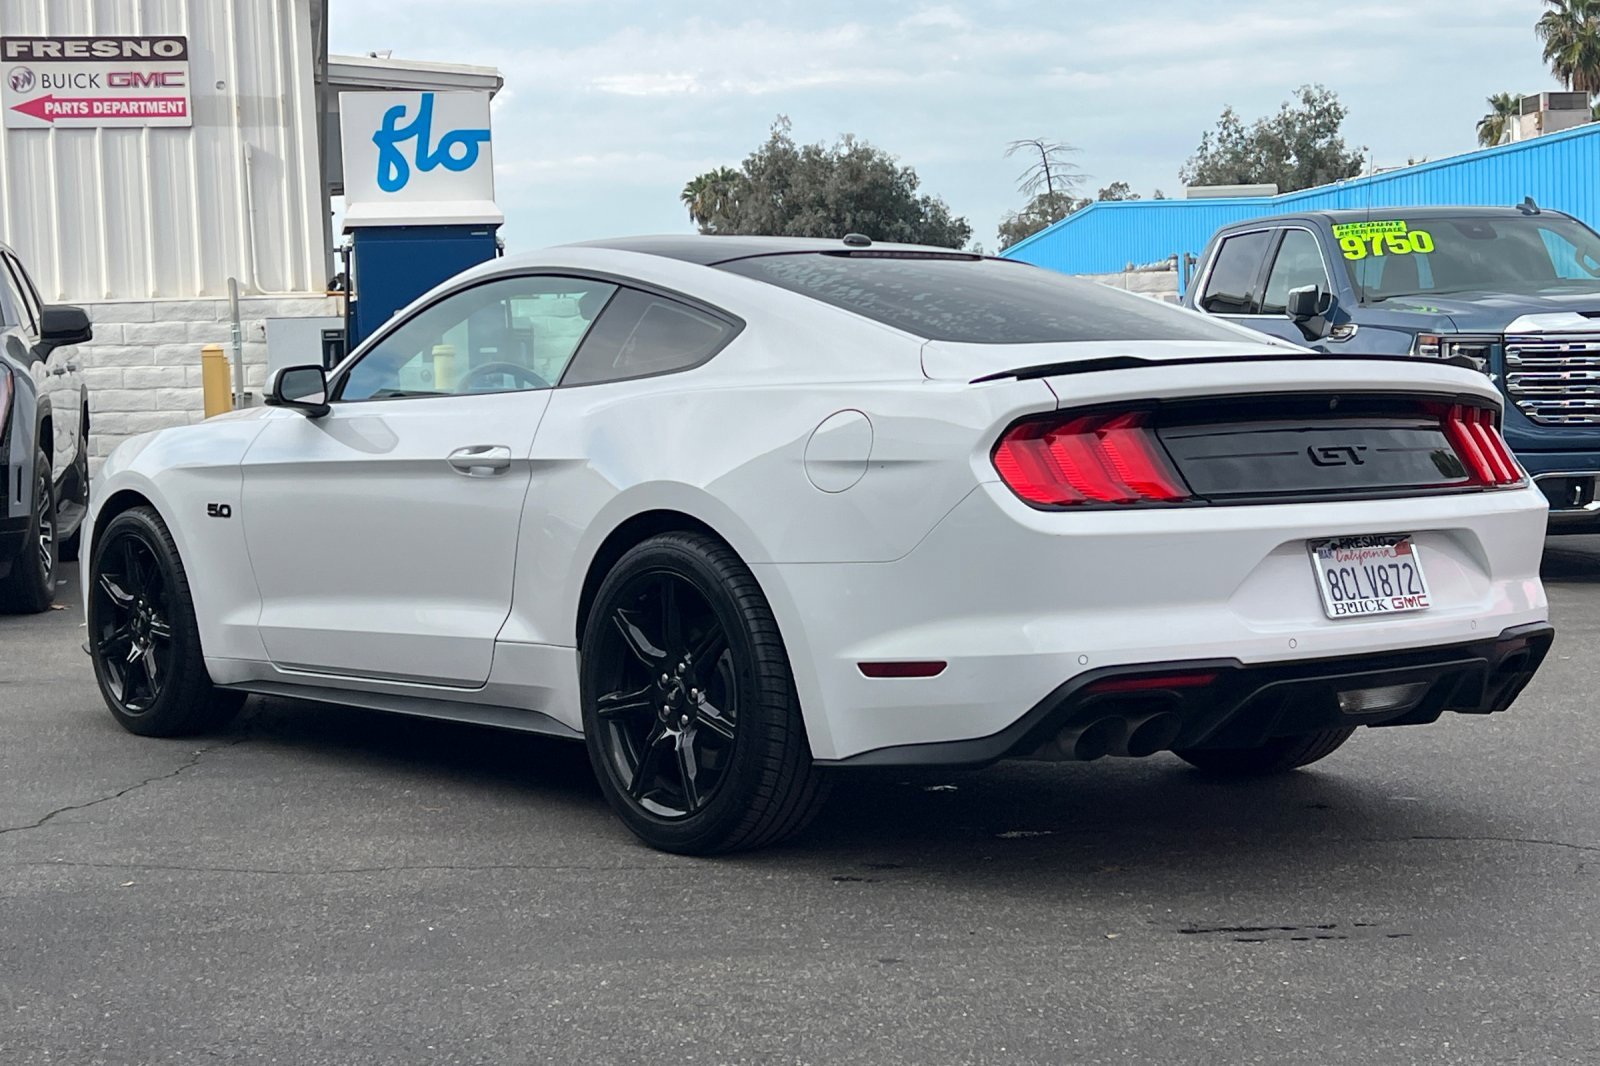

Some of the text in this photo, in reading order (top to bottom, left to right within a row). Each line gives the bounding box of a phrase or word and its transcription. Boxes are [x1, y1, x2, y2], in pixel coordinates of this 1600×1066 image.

[6, 40, 183, 58] FRESNO
[42, 71, 185, 89] BUICK GMC
[44, 101, 184, 115] PARTS DEPARTMENT
[372, 92, 491, 193] flo
[1340, 230, 1435, 260] 9750
[1307, 446, 1367, 467] GT
[1338, 535, 1386, 549] FRESNO
[1327, 562, 1420, 602] 8CLV872
[1333, 595, 1430, 615] BUICK GMC
